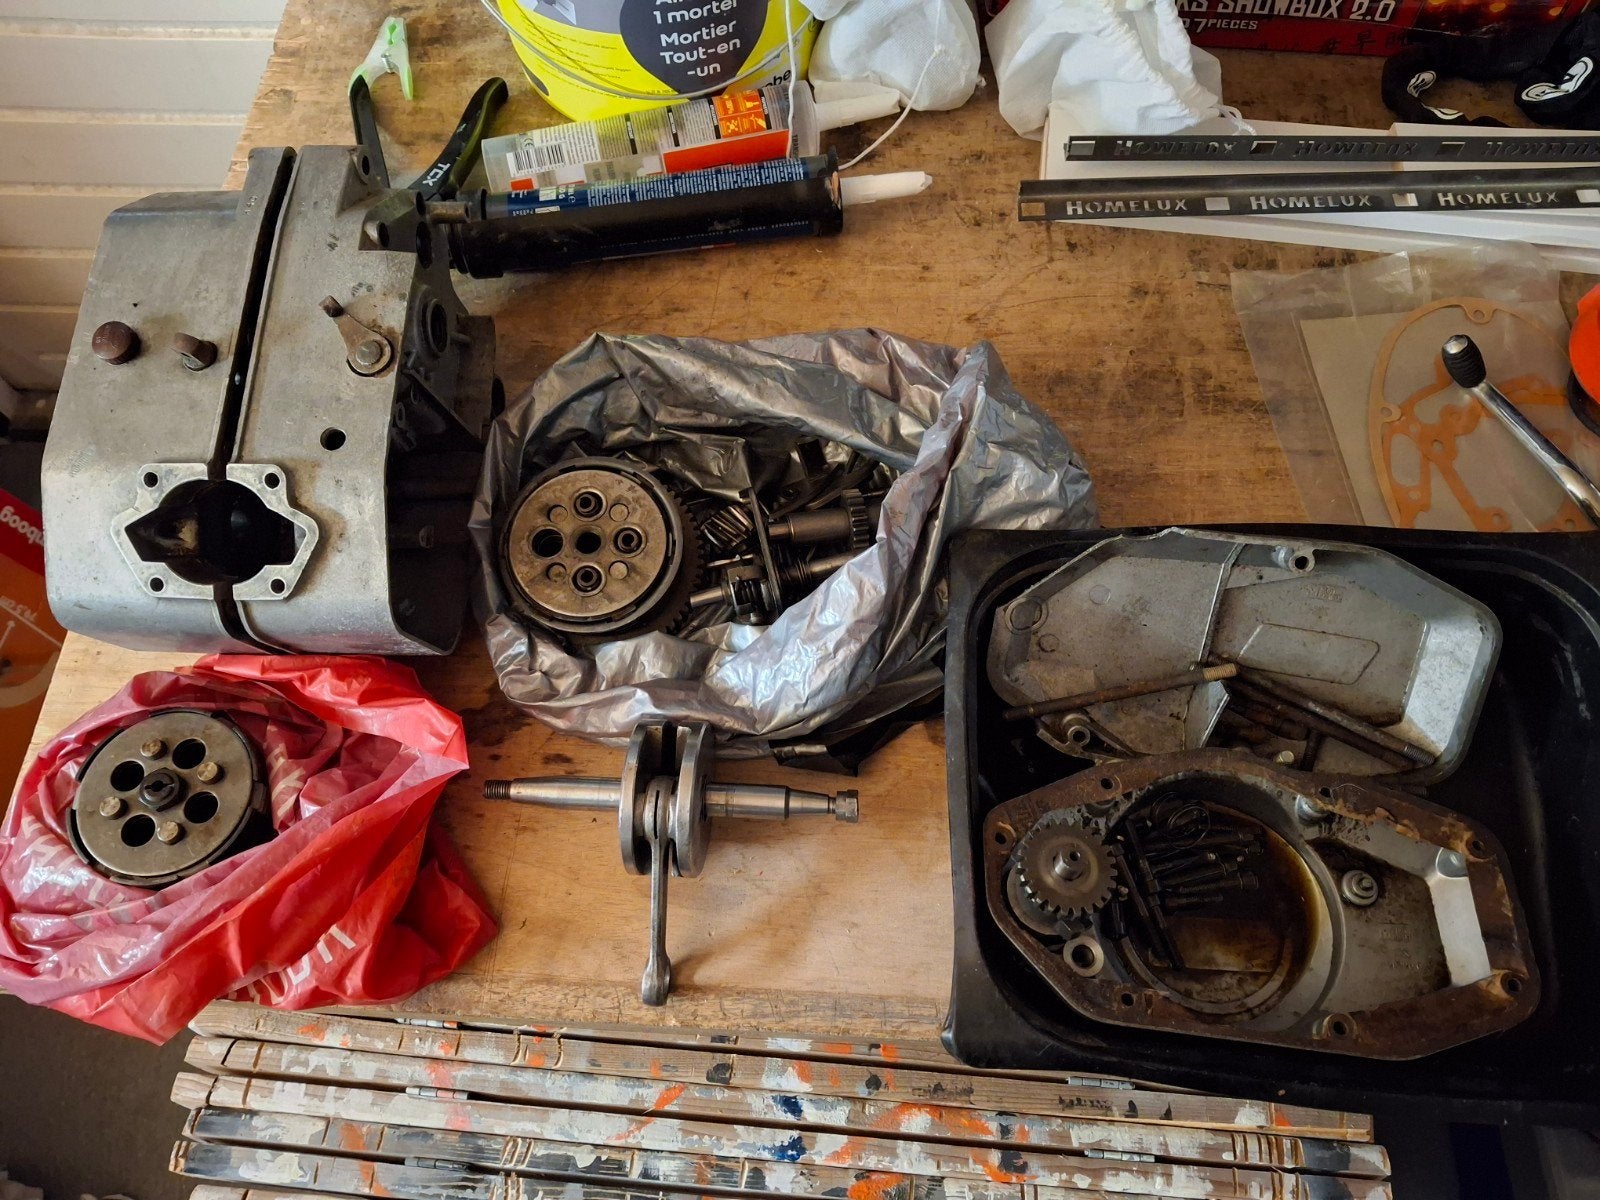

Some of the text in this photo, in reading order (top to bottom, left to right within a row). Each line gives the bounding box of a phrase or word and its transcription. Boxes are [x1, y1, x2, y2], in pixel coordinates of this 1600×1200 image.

[653, 10, 662, 24] 1
[1349, 0, 1396, 22] 2.0
[660, 20, 737, 47] Mortier
[660, 38, 741, 65] Tout-en
[687, 62, 721, 78] -un
[422, 163, 451, 187] TCX
[1066, 198, 1188, 216] HOMELUX
[1250, 195, 1371, 211] HOMELUX
[1437, 191, 1559, 207] HOMELUX
